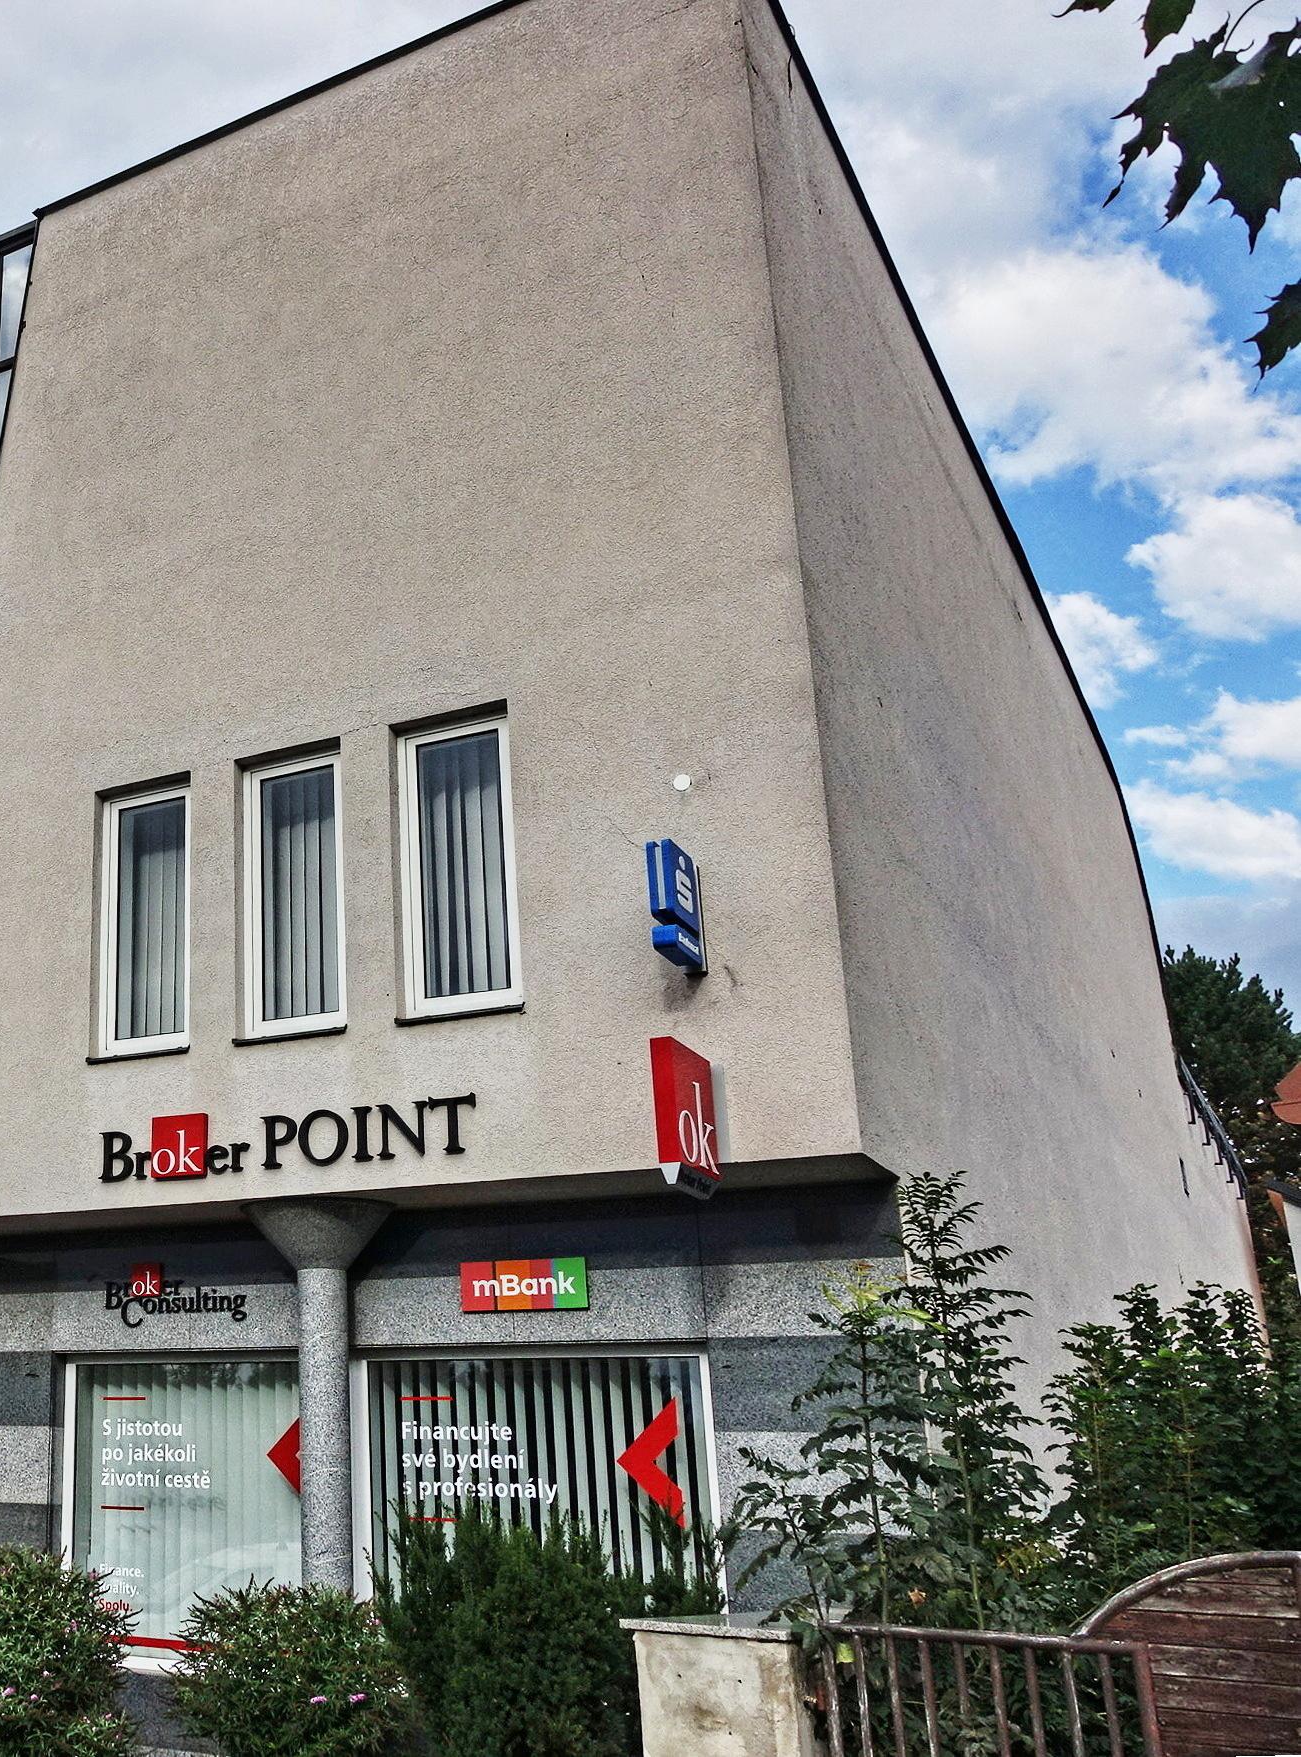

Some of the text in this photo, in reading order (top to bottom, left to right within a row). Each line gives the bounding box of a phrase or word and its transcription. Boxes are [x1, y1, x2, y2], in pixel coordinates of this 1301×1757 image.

[98, 1092, 477, 1183] Broker POINT
[678, 1081, 719, 1175] ok
[105, 1271, 185, 1310] Broker
[472, 1271, 576, 1297] mBank
[120, 1286, 248, 1328] Consulting
[102, 1418, 183, 1440] S jistotou
[401, 1420, 513, 1445] Financujte
[101, 1443, 197, 1466] po jakékoli
[402, 1447, 526, 1473] své bydlení
[101, 1467, 211, 1489] životní cestě
[402, 1477, 558, 1504] s profesionály
[98, 1598, 133, 1614] Spolu.
